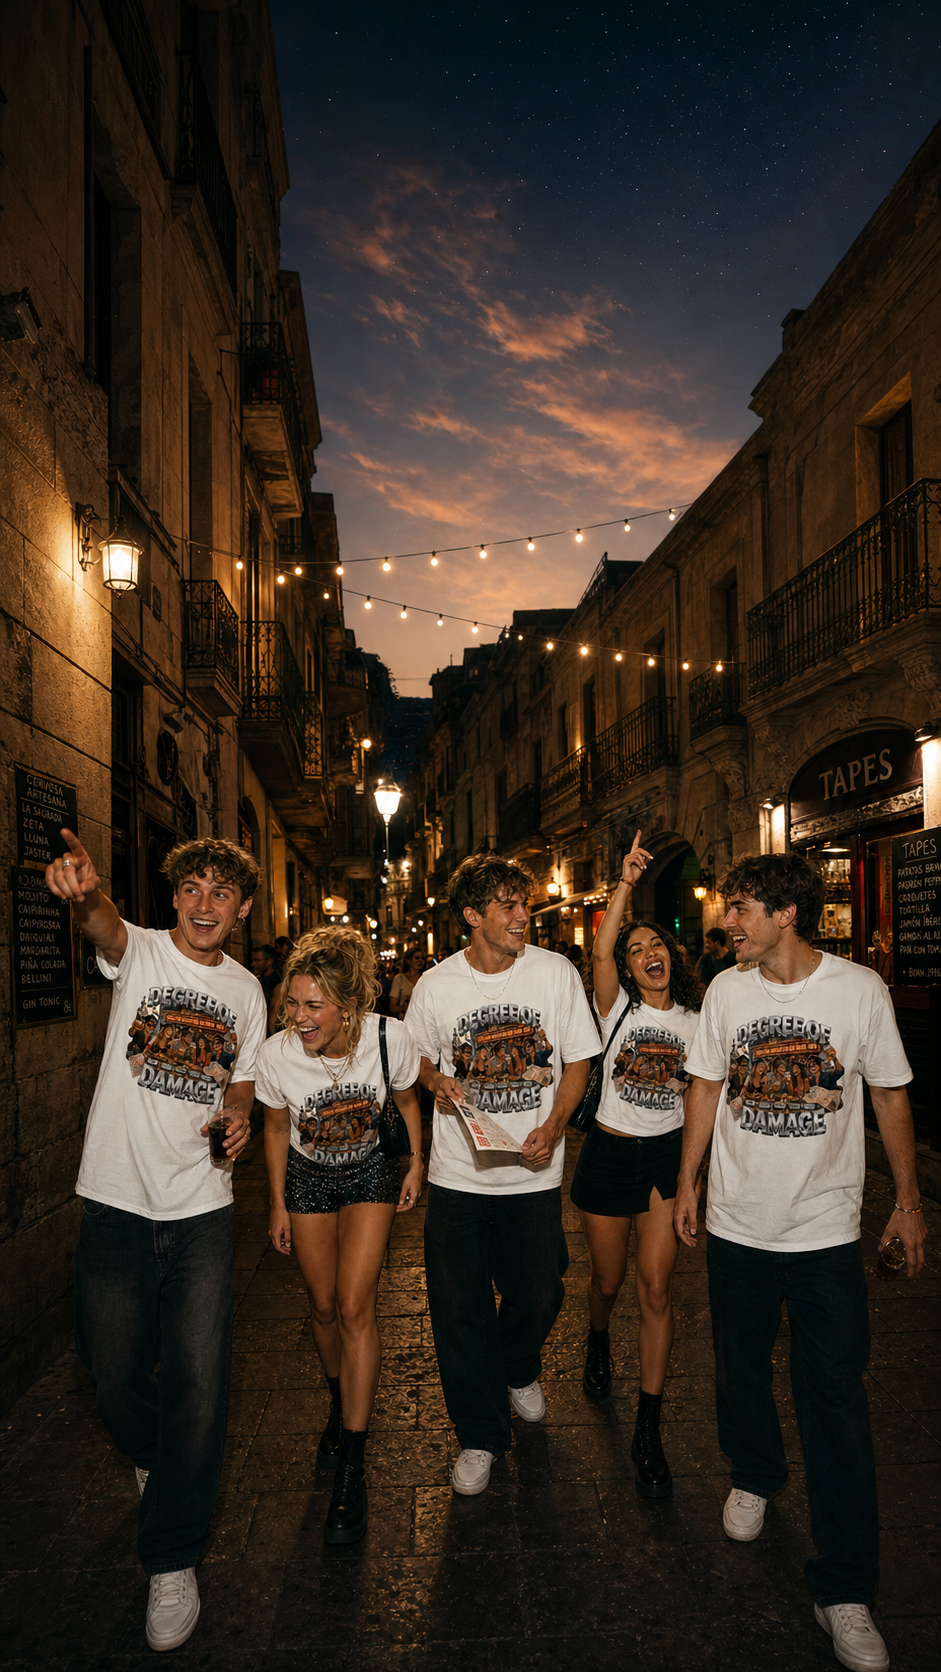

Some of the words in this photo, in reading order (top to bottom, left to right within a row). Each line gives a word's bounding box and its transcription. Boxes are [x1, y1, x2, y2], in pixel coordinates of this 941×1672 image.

[818, 748, 893, 801] TAPES
[27, 787, 67, 809] ARTESANA
[22, 803, 31, 814] LA
[23, 817, 44, 832] ZETA
[24, 832, 49, 846] LLUNA
[24, 846, 51, 860] JASTER
[902, 838, 937, 859] TAPES
[18, 890, 50, 903] MOJITO
[21, 973, 52, 984] BELLINI
[22, 999, 37, 1010] GIN
[138, 1066, 218, 1105] DAMAGE
[476, 1083, 542, 1114] AMAGE
[619, 1083, 680, 1111] DAMAGE
[740, 1106, 827, 1138] DAMAGE
